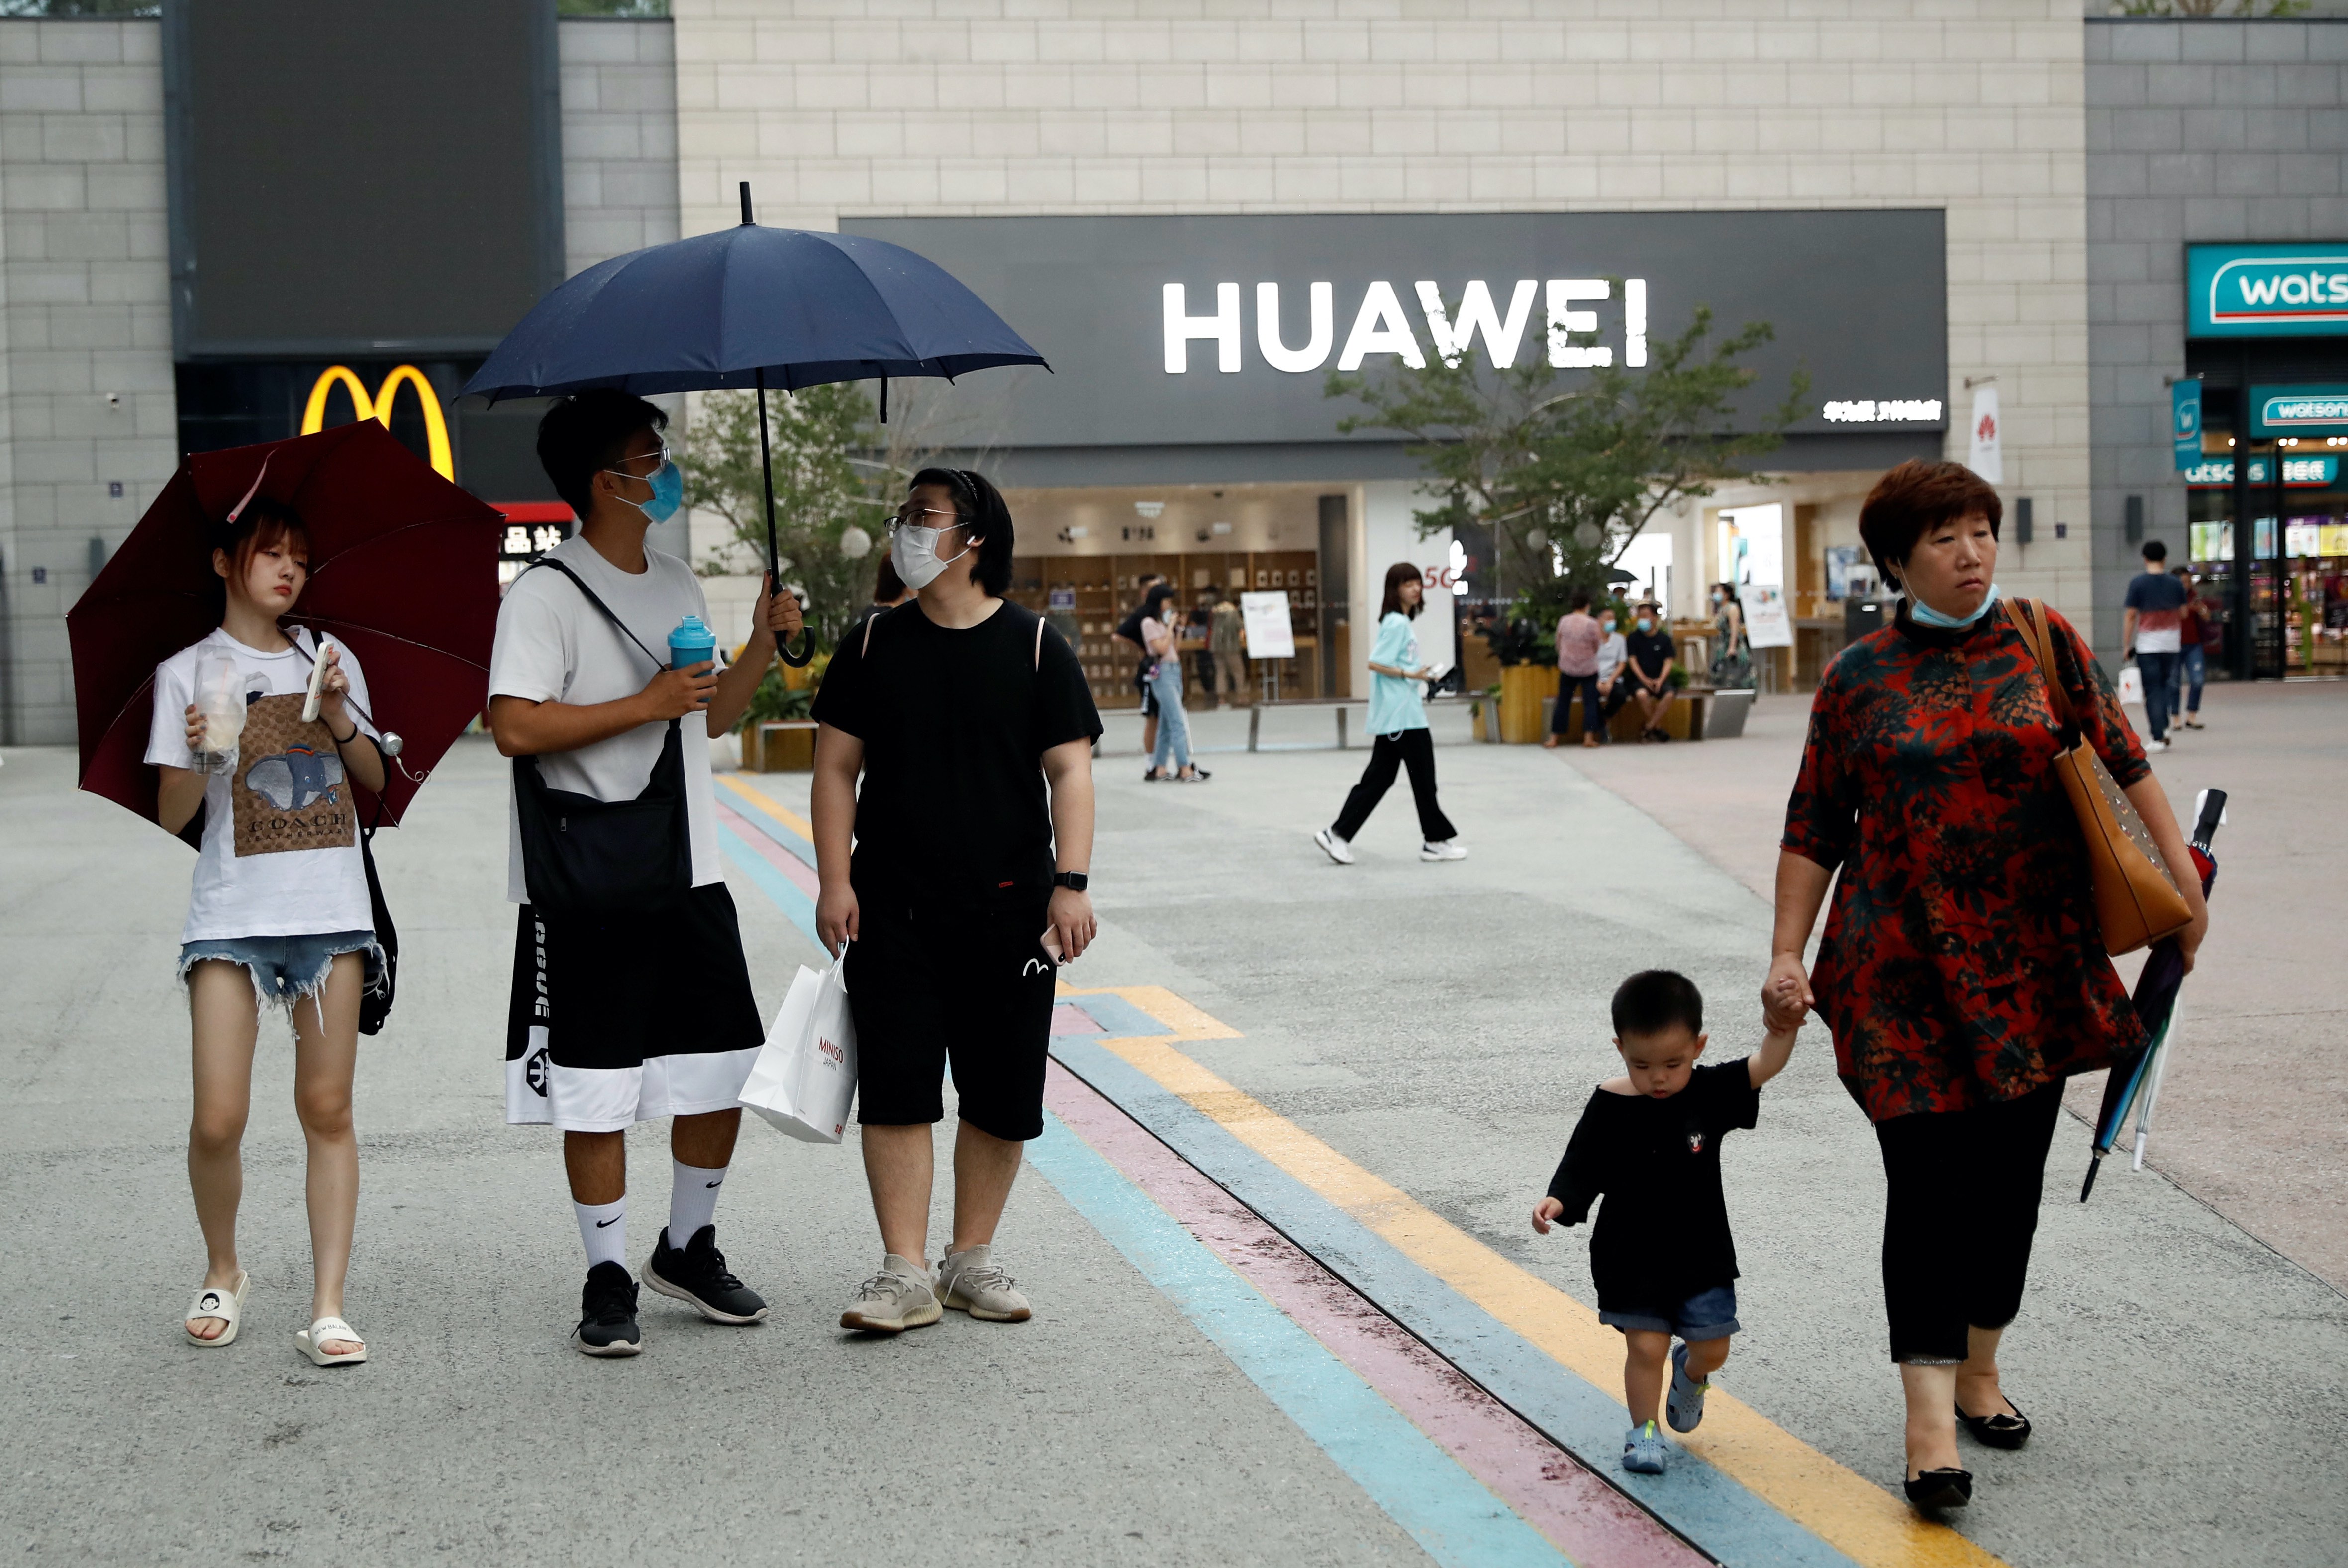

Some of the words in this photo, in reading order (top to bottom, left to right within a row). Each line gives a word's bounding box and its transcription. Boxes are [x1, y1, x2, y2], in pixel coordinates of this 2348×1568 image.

[2239, 270, 2348, 305] wats
[1163, 280, 1647, 373] HUAWEI
[2278, 402, 2348, 418] watson
[247, 813, 346, 832] COACH
[818, 1036, 843, 1064] MINISO
[823, 1057, 837, 1071] JAPAN
[315, 1326, 327, 1335] NEW
